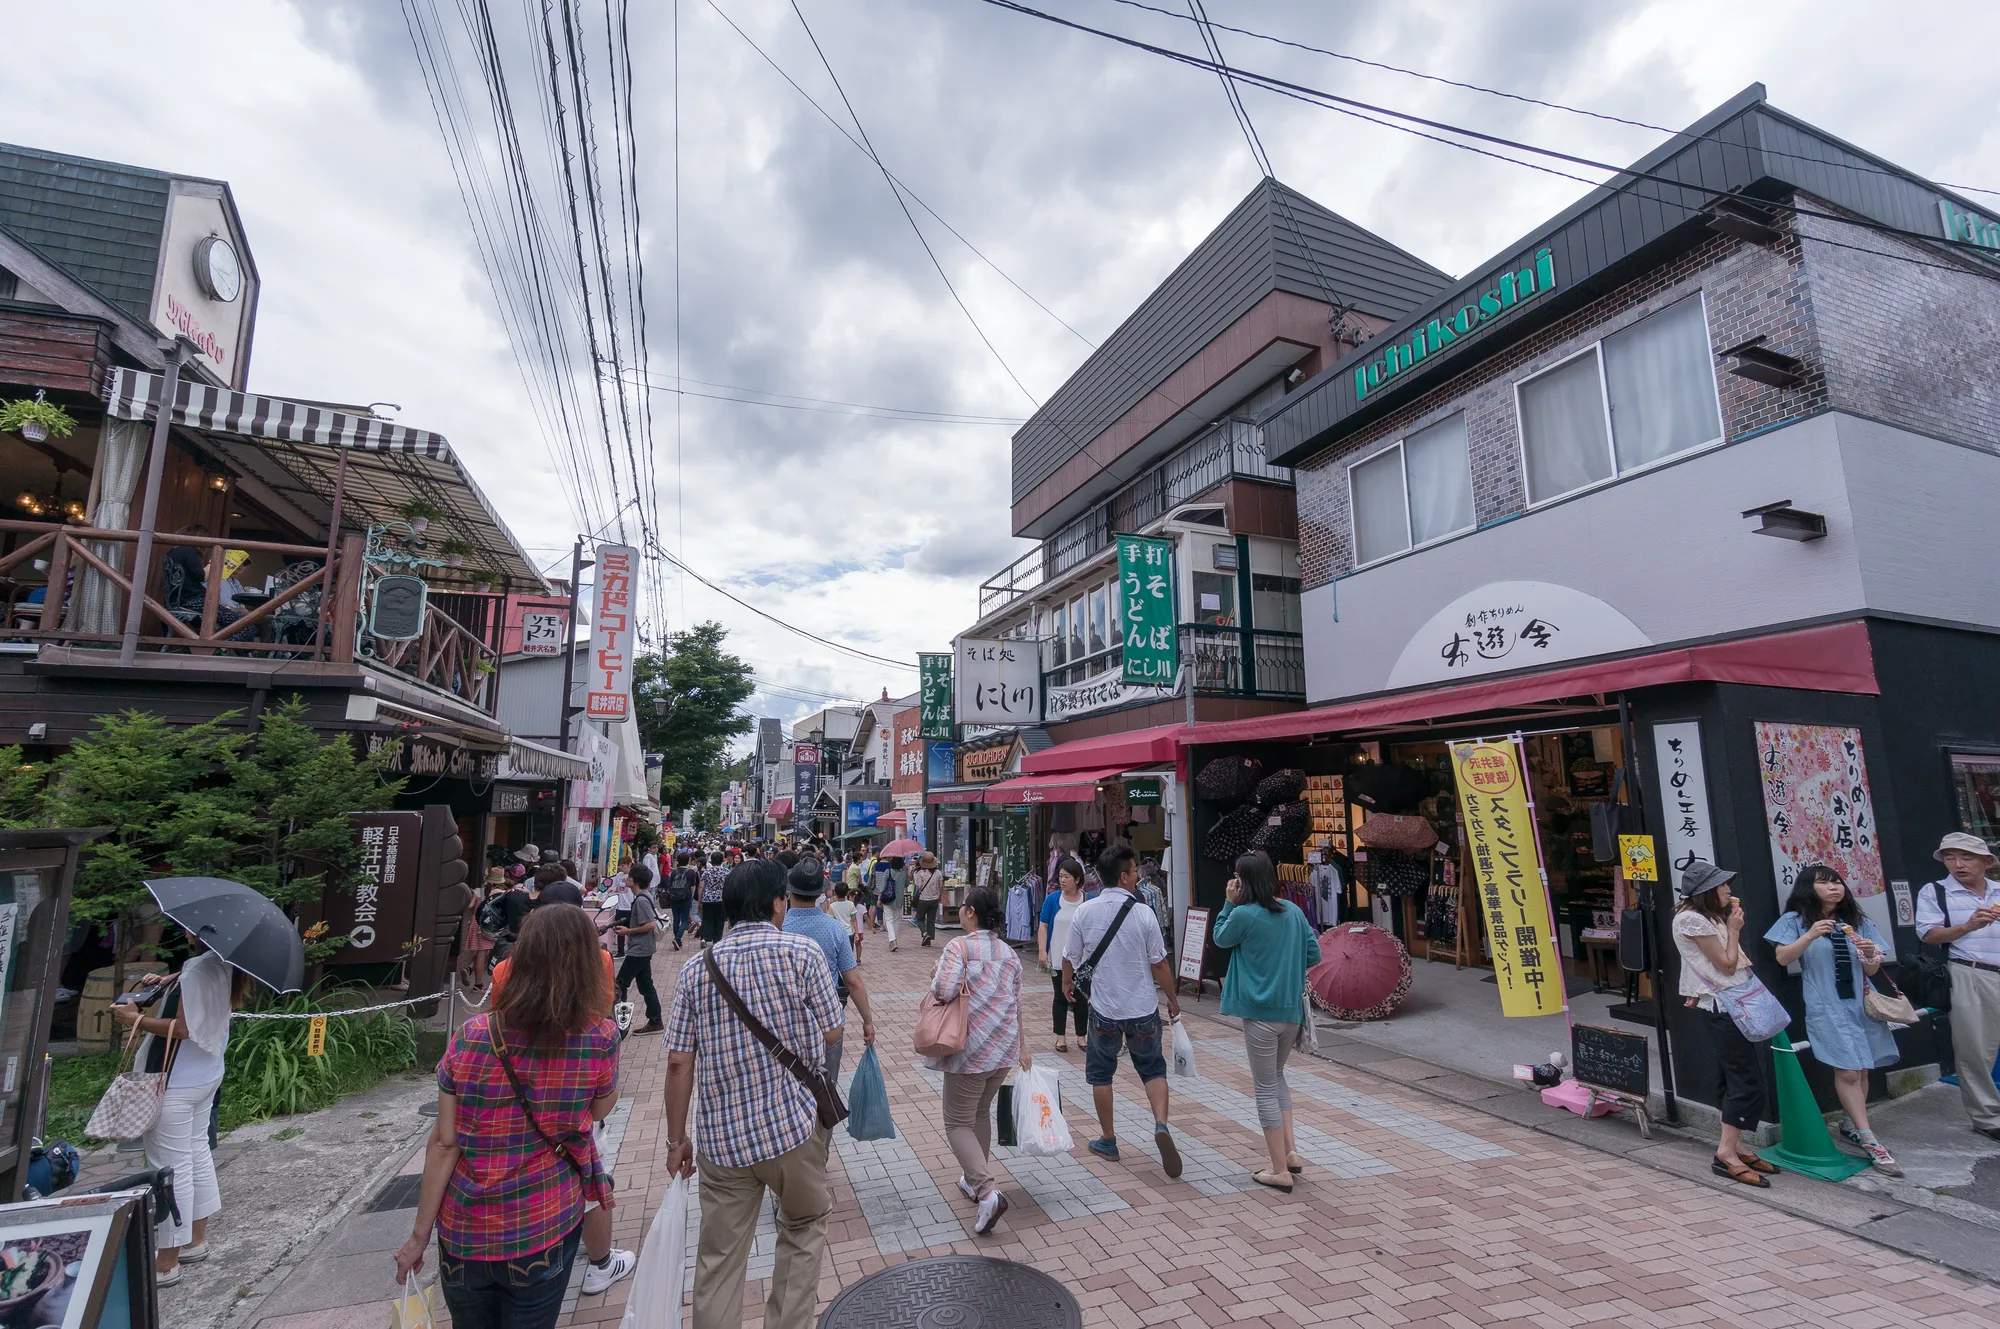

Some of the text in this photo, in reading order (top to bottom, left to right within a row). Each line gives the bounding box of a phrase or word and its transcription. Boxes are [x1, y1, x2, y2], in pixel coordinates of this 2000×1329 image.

[1355, 247, 1556, 401] Ichikoshi
[1465, 604, 1524, 628] 創作ちりめん
[523, 644, 557, 653] 軽井沢名物
[967, 647, 1016, 661] そば処
[1127, 658, 1171, 678] にし川
[590, 695, 624, 712] 軽井沢店
[976, 681, 1034, 715] にし川
[921, 726, 949, 738] にし川
[1128, 789, 1159, 798] Stream
[1667, 737, 1701, 838] ちりめん工房
[1843, 741, 1870, 847] ちりめんの
[1833, 795, 1854, 849] お店
[383, 826, 399, 884] 日本基督教団
[354, 826, 384, 922] 軽井沢教会
